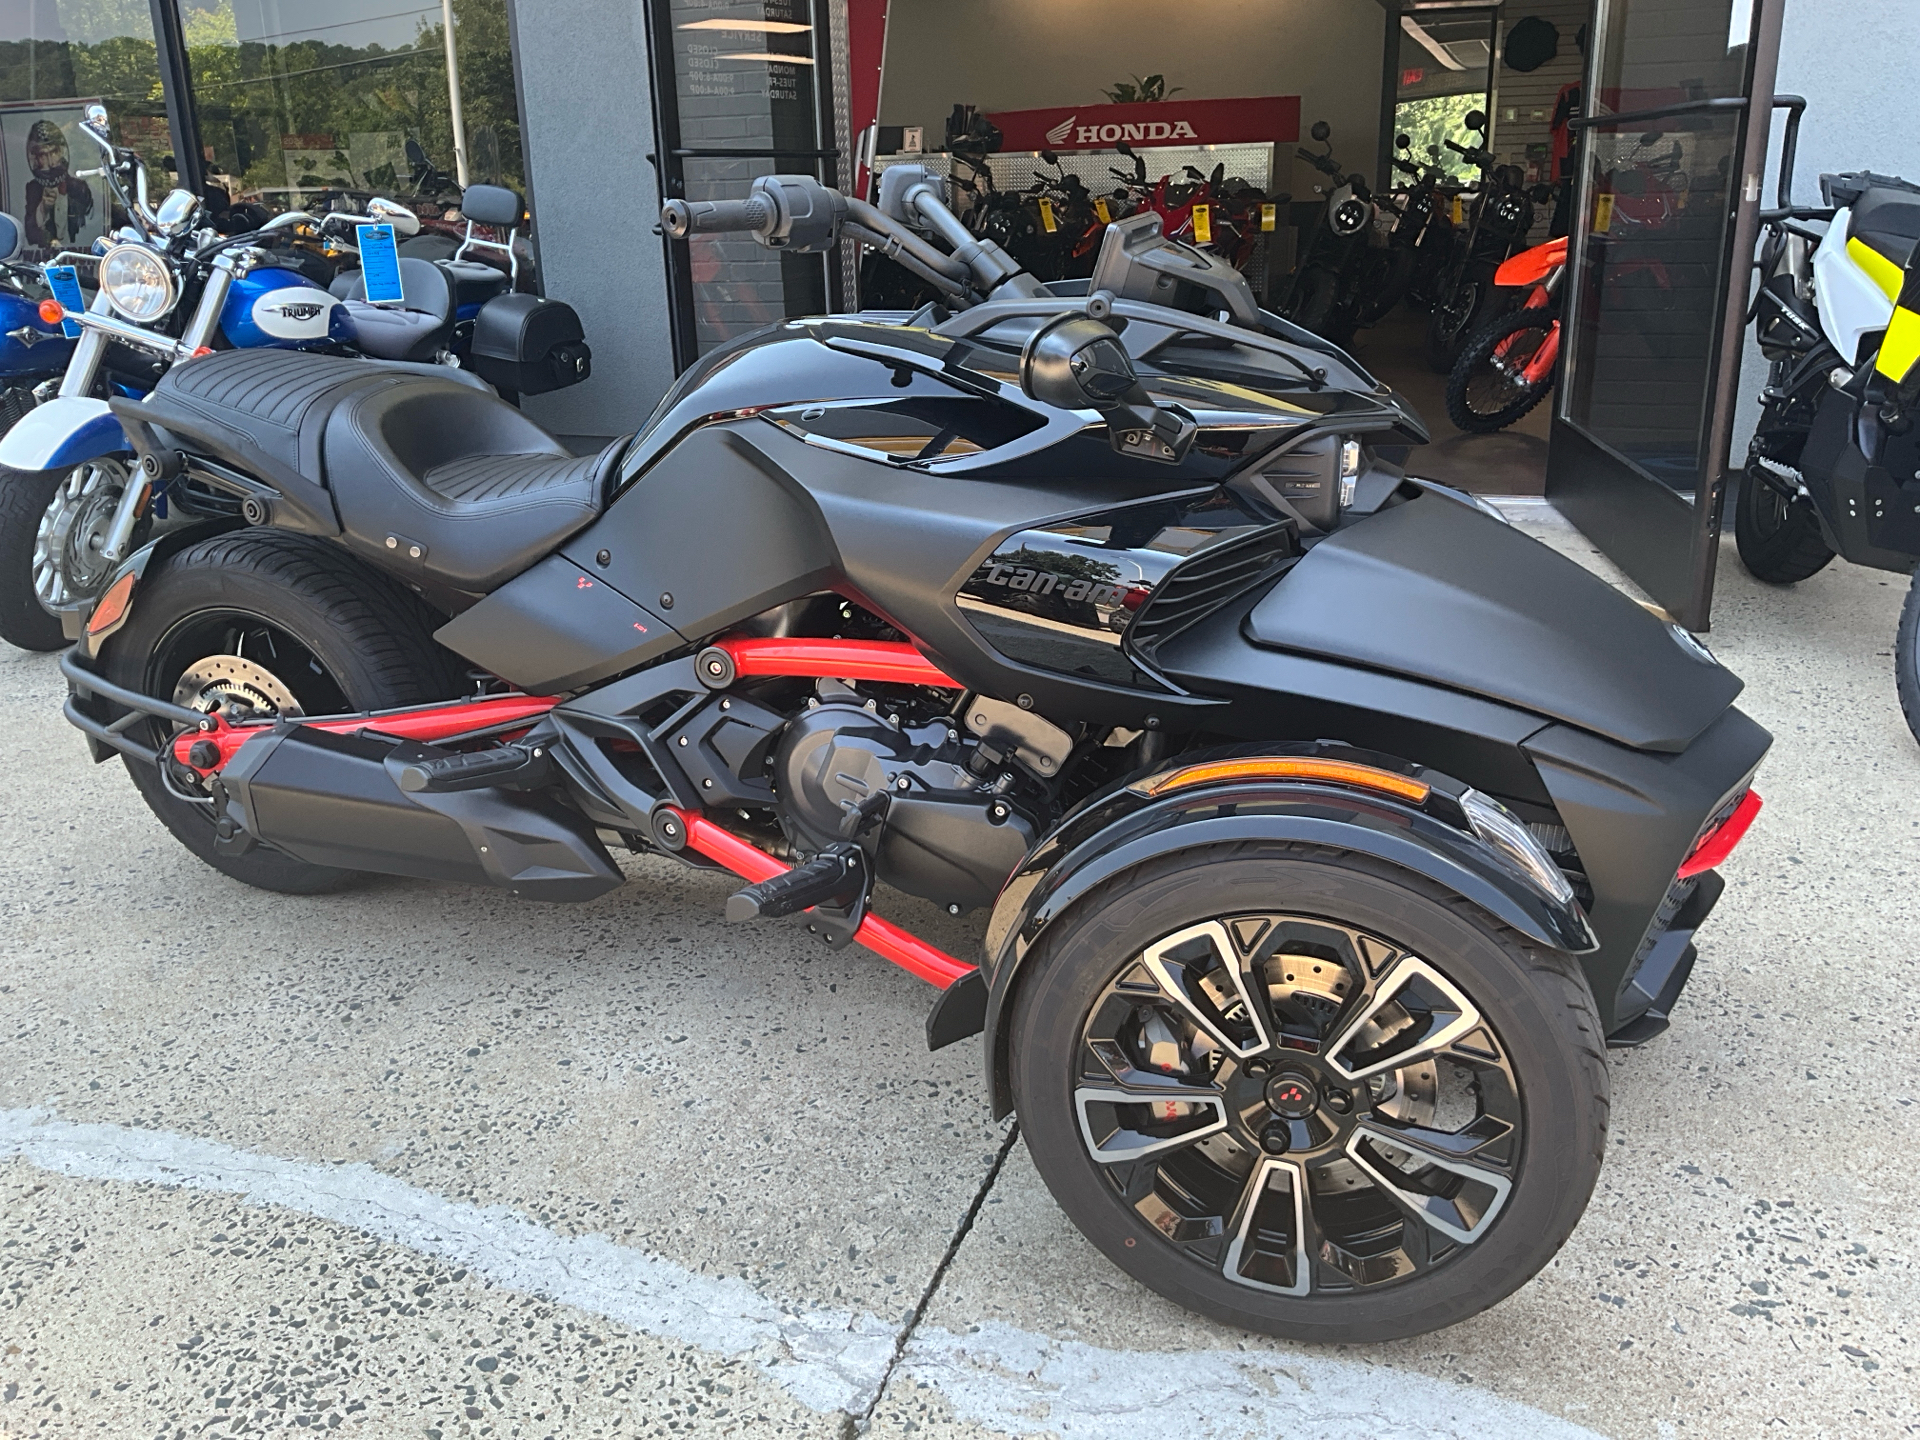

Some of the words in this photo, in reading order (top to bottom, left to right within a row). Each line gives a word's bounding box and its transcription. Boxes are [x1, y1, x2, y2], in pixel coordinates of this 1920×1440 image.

[1075, 121, 1198, 144] HONDA
[281, 306, 321, 320] TRIUMPH
[1780, 306, 1809, 330] TUSK
